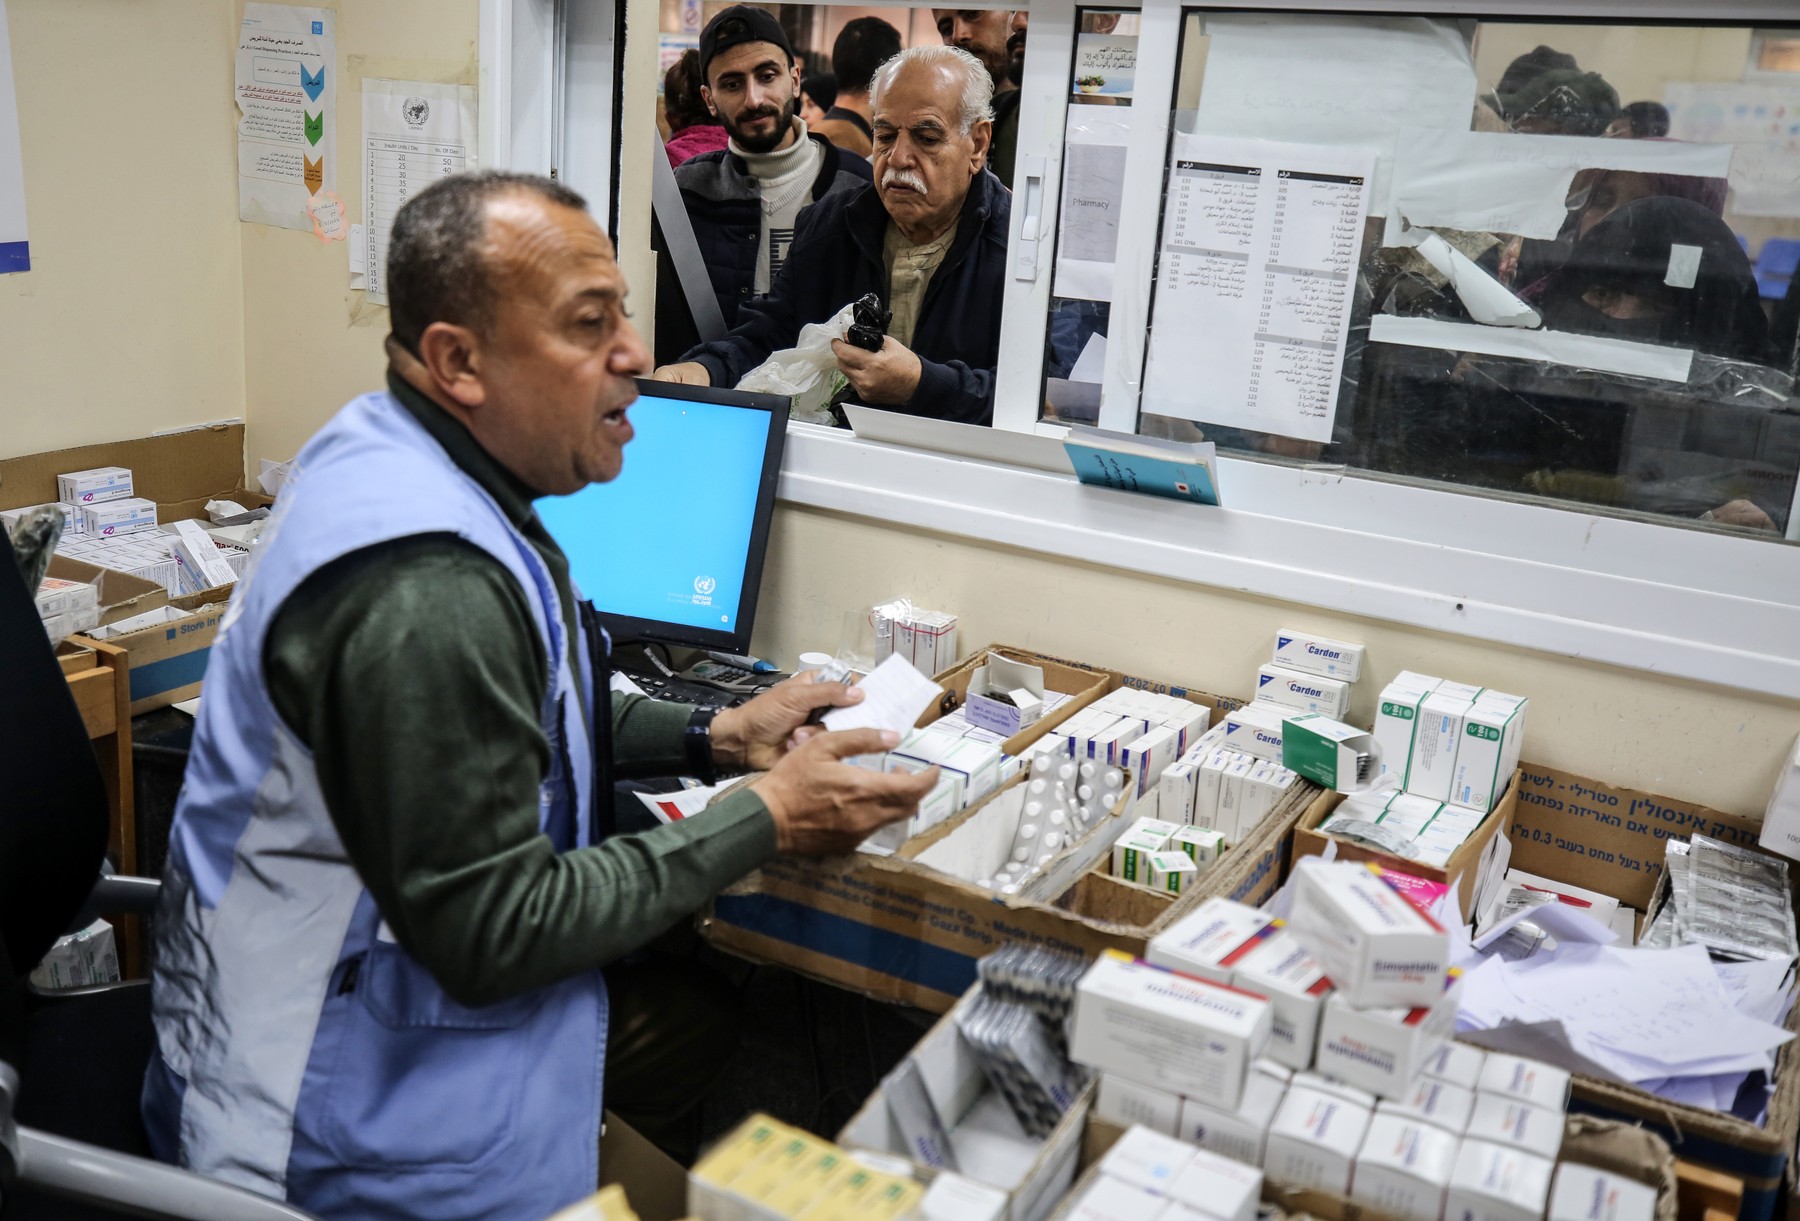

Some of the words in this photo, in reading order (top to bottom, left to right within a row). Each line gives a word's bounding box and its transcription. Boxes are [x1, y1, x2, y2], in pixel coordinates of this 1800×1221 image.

[1072, 198, 1110, 210] Pharmacy
[180, 621, 205, 634] Store
[1308, 645, 1340, 660] Cardon
[1122, 674, 1166, 695] 07.2020
[1289, 683, 1322, 698] Cardon
[1256, 731, 1282, 746] Cardo
[1570, 784, 1618, 807] סטרילי
[1568, 804, 1622, 827] האריזה
[1629, 797, 1707, 830] אינסולין
[1626, 821, 1648, 835] אם
[1710, 820, 1760, 847] מזרק
[1532, 829, 1551, 845] 0.3
[1555, 836, 1585, 855] בעובי
[1588, 846, 1615, 864] מחט
[1619, 853, 1641, 870] בעל
[992, 920, 1028, 940] Made
[1048, 936, 1086, 957] China
